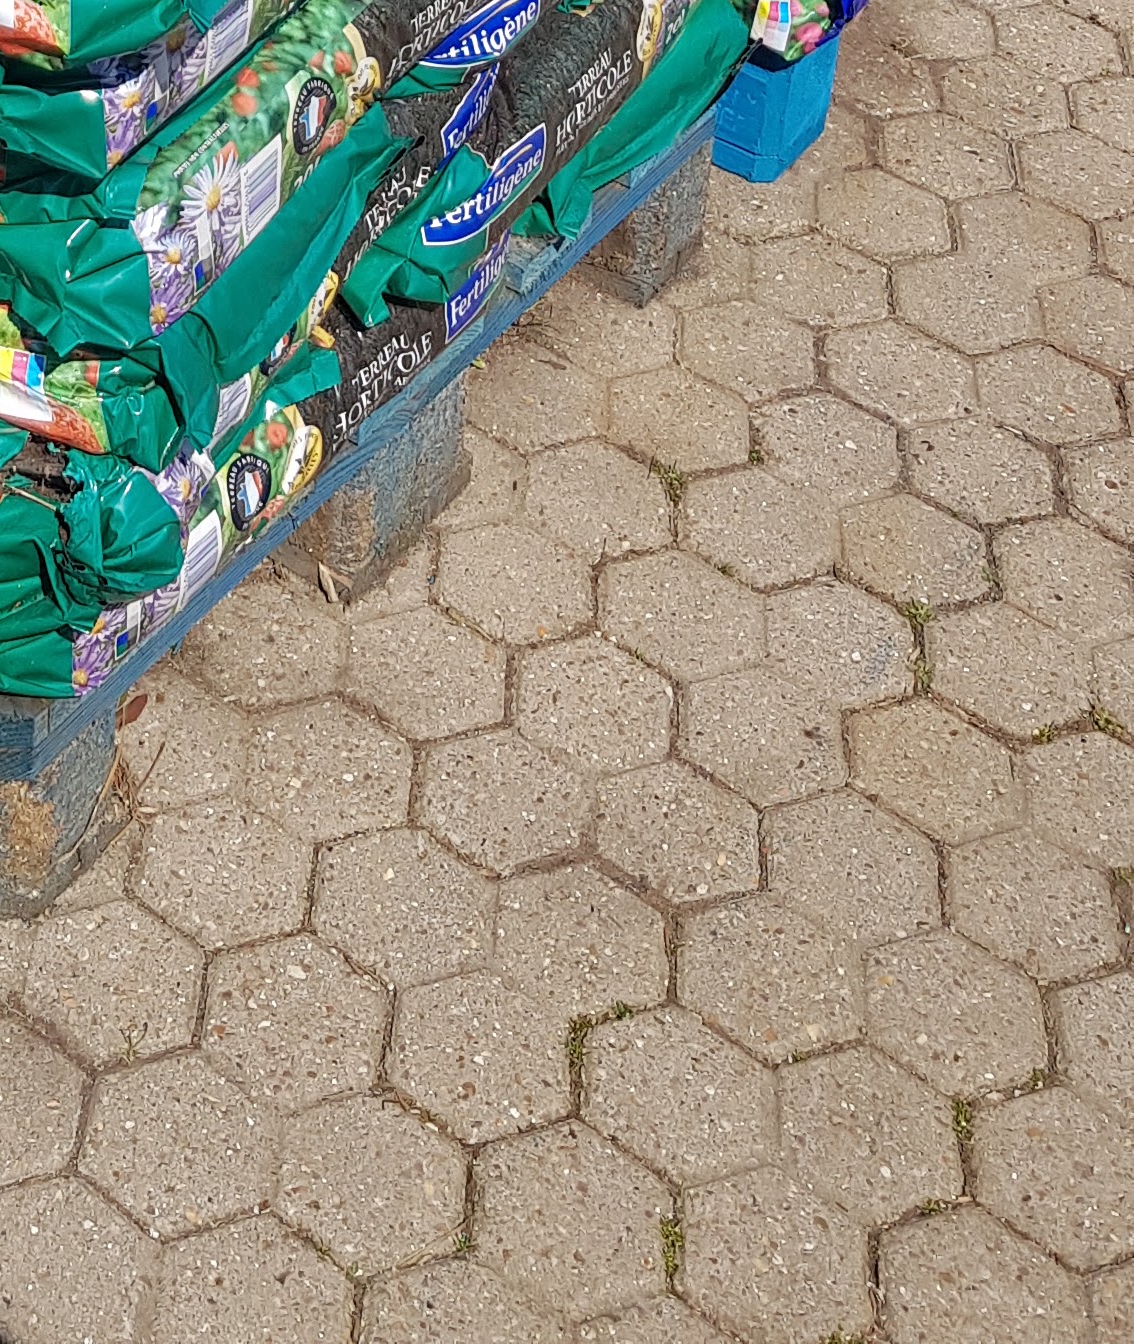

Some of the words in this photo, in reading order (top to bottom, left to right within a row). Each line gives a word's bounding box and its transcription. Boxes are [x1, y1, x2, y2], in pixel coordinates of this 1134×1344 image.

[556, 49, 633, 144] HORTICOLE
[568, 47, 613, 96] TERREAU
[353, 328, 412, 390] TERREAU
